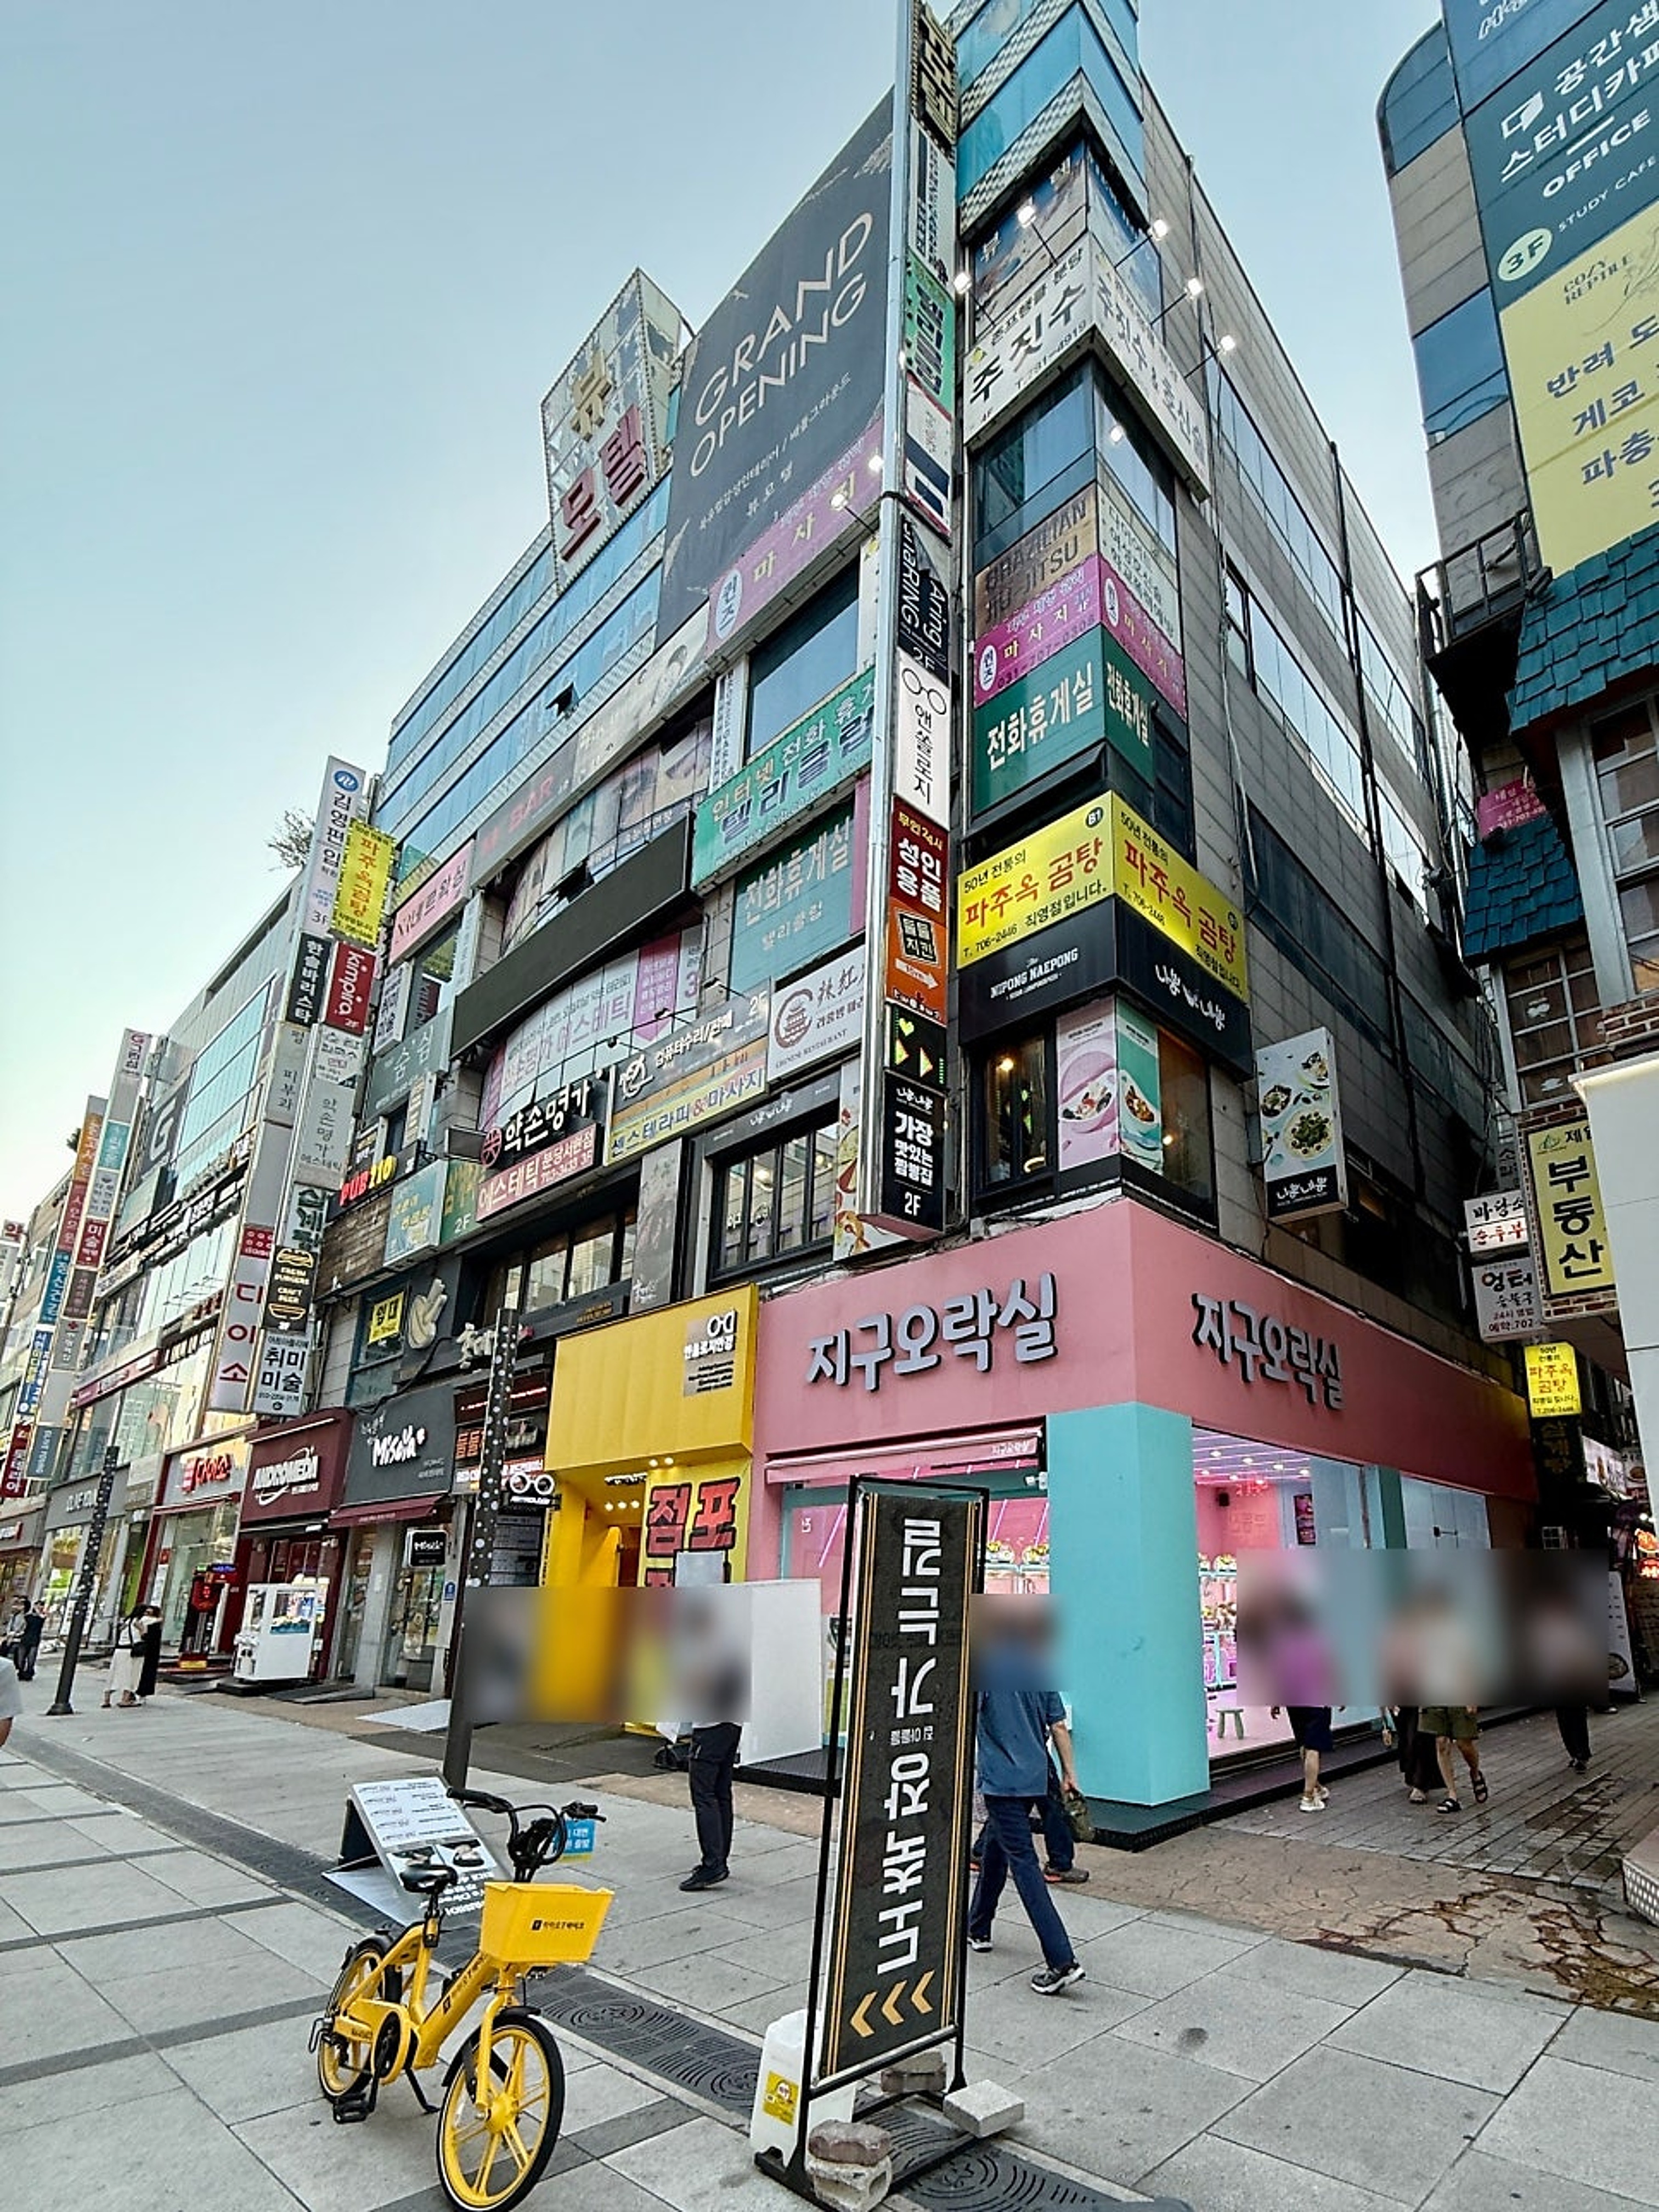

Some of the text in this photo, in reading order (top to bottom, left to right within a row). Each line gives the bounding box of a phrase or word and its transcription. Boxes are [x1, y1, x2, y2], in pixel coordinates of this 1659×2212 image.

[1543, 110, 1651, 197] OFFICE
[1559, 155, 1657, 232] STUDY CAFE
[1507, 234, 1544, 274] 3F
[695, 211, 873, 427] GRAND
[969, 282, 1086, 405] 주짓수
[691, 273, 867, 477] OPENING
[1547, 341, 1615, 398] 반려
[1572, 380, 1645, 436] 게코
[558, 403, 650, 564] 모텔
[1581, 428, 1659, 485] 파충
[987, 661, 1093, 770] 전화휴게실
[1107, 662, 1149, 747] 전화휴게실
[744, 816, 851, 927] 전화휴게실
[898, 837, 941, 883] 성인
[963, 849, 1026, 893] 50년 전통의
[964, 837, 1104, 928] 파주옥 곰탕
[896, 865, 941, 913] 용품
[1025, 878, 1107, 927] 직영점입니다.
[1124, 839, 1237, 964] 파주옥 곰탕
[337, 950, 368, 1017] kimpira
[990, 947, 1079, 998] NIPONG NAEPONG
[505, 1079, 592, 1151] 약손명가
[611, 1104, 690, 1155] 센스테라피
[708, 1070, 764, 1107] 마사지
[894, 1111, 933, 1148] 가장
[340, 1170, 370, 1207] PUB
[369, 1155, 397, 1189] 210
[894, 1138, 933, 1169] 맛있는
[894, 1156, 933, 1187] 짬뽕집
[478, 1156, 539, 1209] 에스테틱
[904, 1192, 921, 1216] 2F
[455, 1212, 471, 1234] 2F
[1548, 1154, 1604, 1280] 부동산
[264, 1347, 306, 1370] 취미
[806, 1273, 1057, 1391] 지구오락실
[1192, 1292, 1345, 1409] 지구오락실
[261, 1370, 302, 1393] 미술
[253, 1455, 319, 1490] ANDROMEDA
[646, 1477, 740, 1557] 점포
